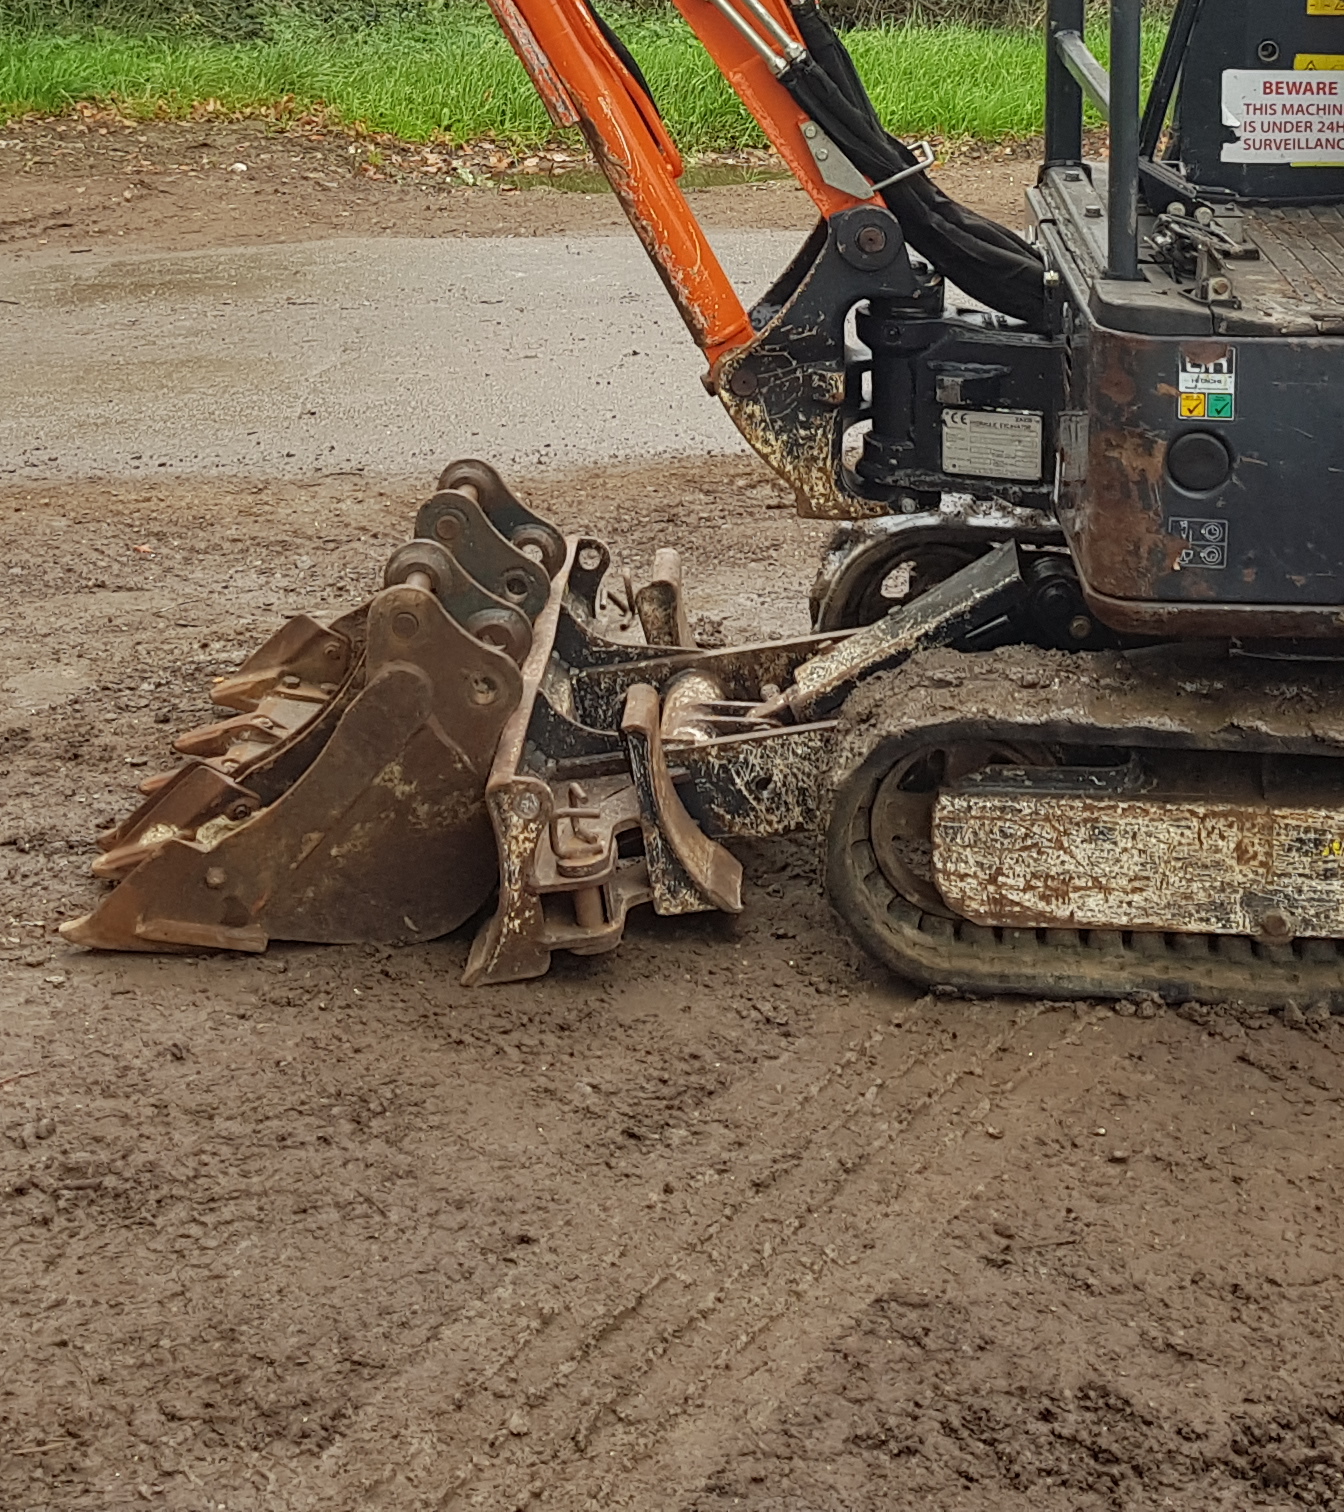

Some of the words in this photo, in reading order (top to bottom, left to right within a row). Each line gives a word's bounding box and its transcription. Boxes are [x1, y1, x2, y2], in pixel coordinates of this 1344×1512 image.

[1262, 81, 1339, 95] BEWARE
[1243, 103, 1277, 116] THIS
[1243, 121, 1256, 133] IS
[1260, 121, 1313, 133] UNDER
